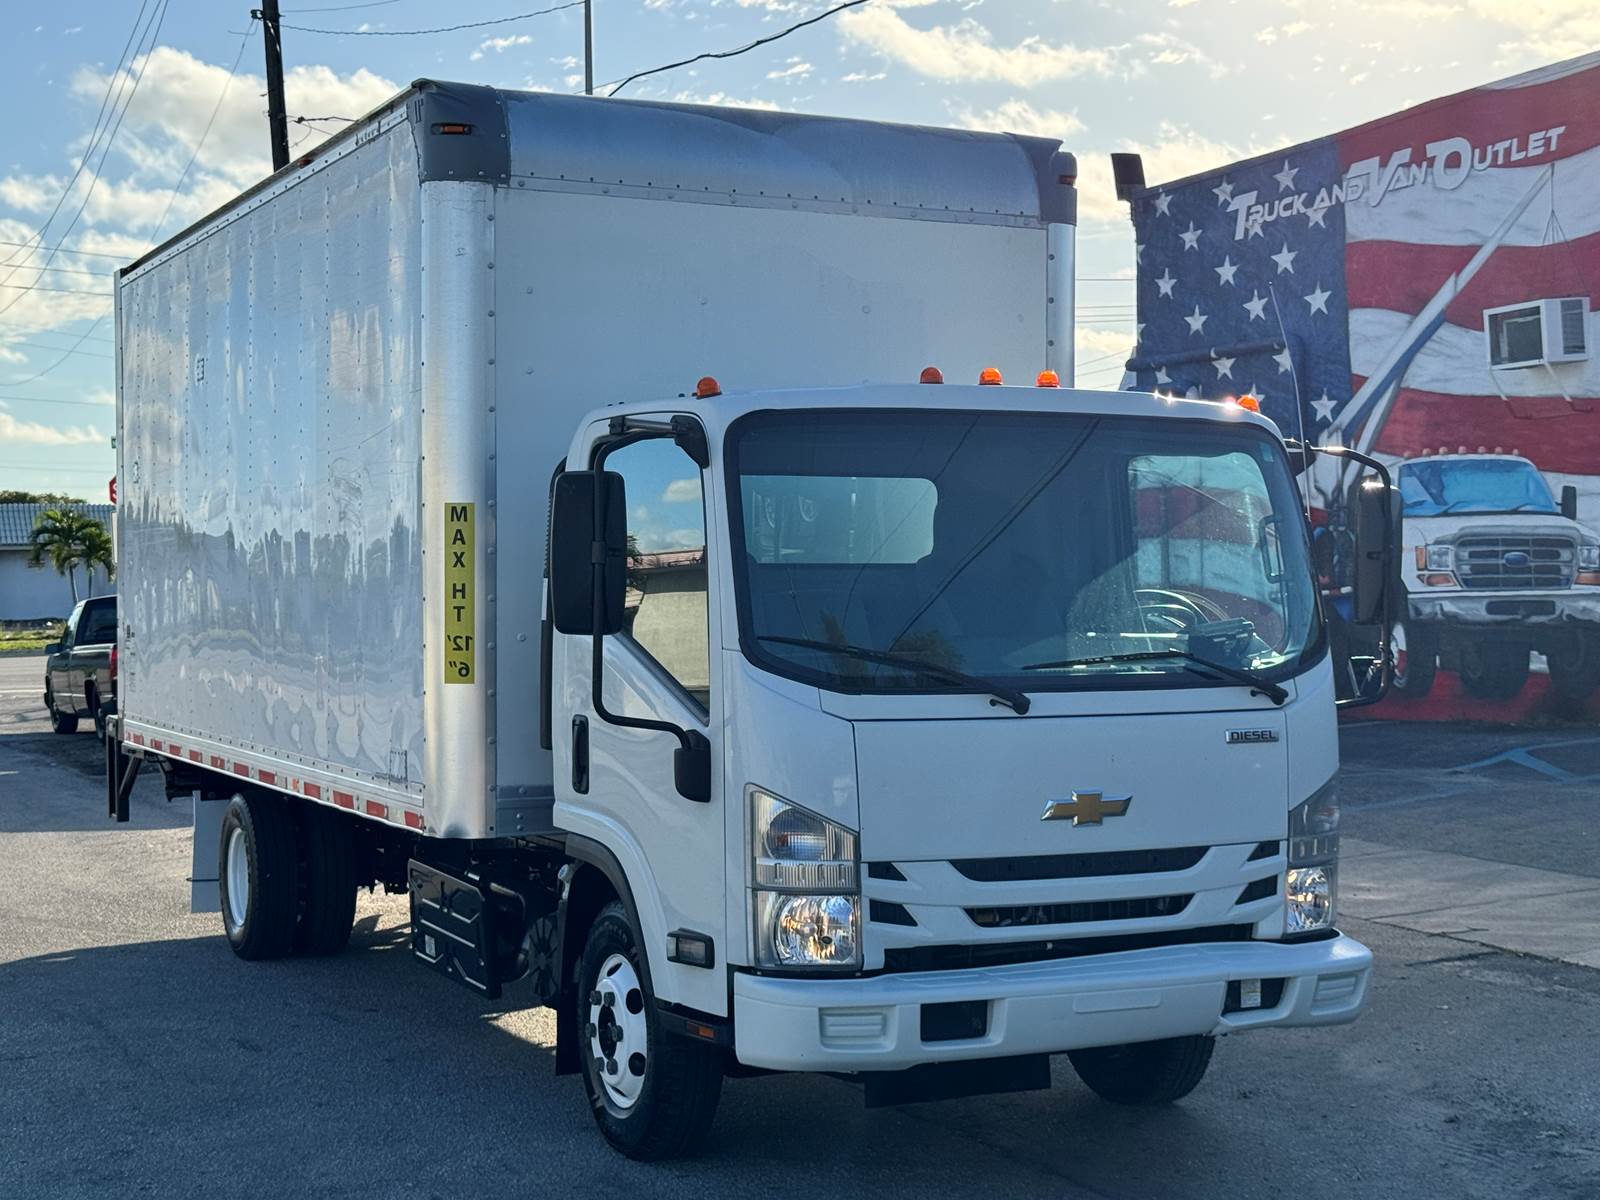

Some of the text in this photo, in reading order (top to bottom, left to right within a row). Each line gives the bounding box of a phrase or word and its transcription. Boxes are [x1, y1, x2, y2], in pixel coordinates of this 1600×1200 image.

[1346, 148, 1427, 208] VAN
[1425, 126, 1567, 190] OUTLET
[450, 505, 469, 568] MAX
[452, 582, 467, 623] HT
[1230, 730, 1277, 741] DIESEL
